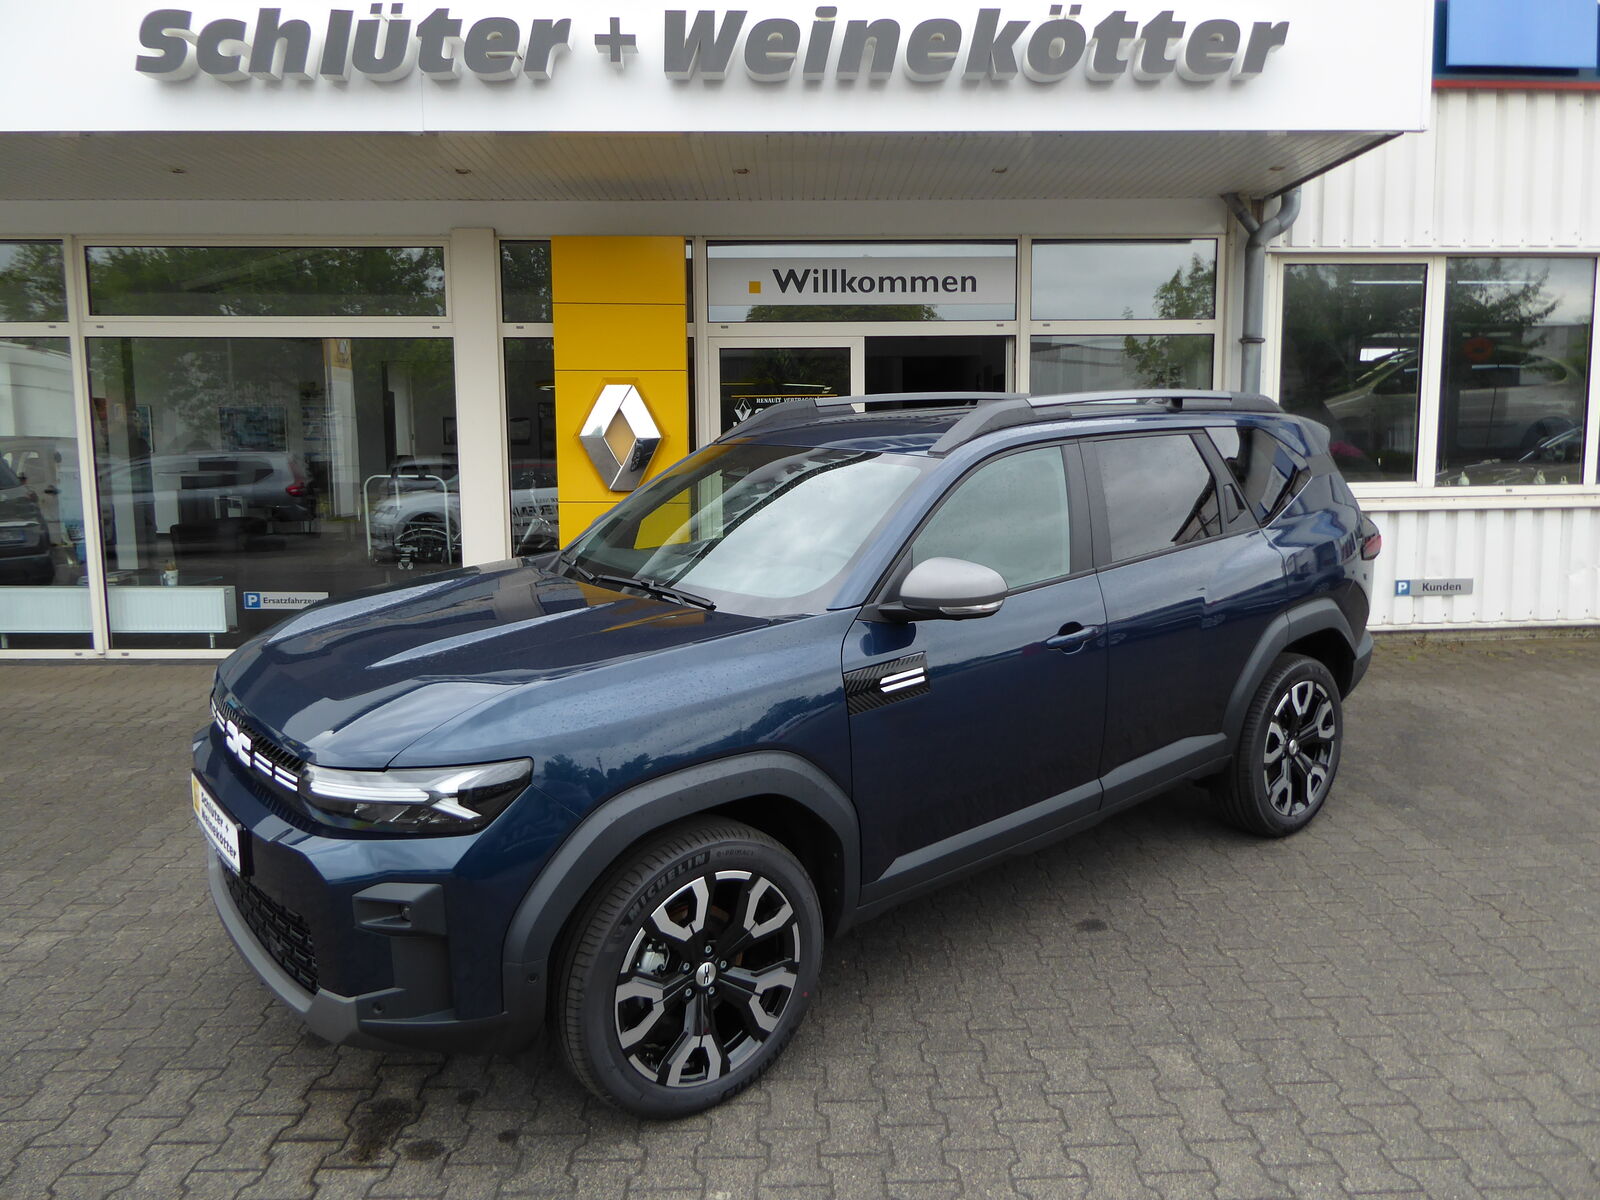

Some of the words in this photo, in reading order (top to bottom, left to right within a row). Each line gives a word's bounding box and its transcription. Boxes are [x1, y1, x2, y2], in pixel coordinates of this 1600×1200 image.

[135, 2, 572, 75] Schlüter
[594, 16, 637, 63] +
[664, 3, 1290, 75] Weinekötter
[772, 268, 977, 294] Willkommen
[1422, 582, 1462, 592] Kunden
[628, 852, 706, 921] MICHELIN
